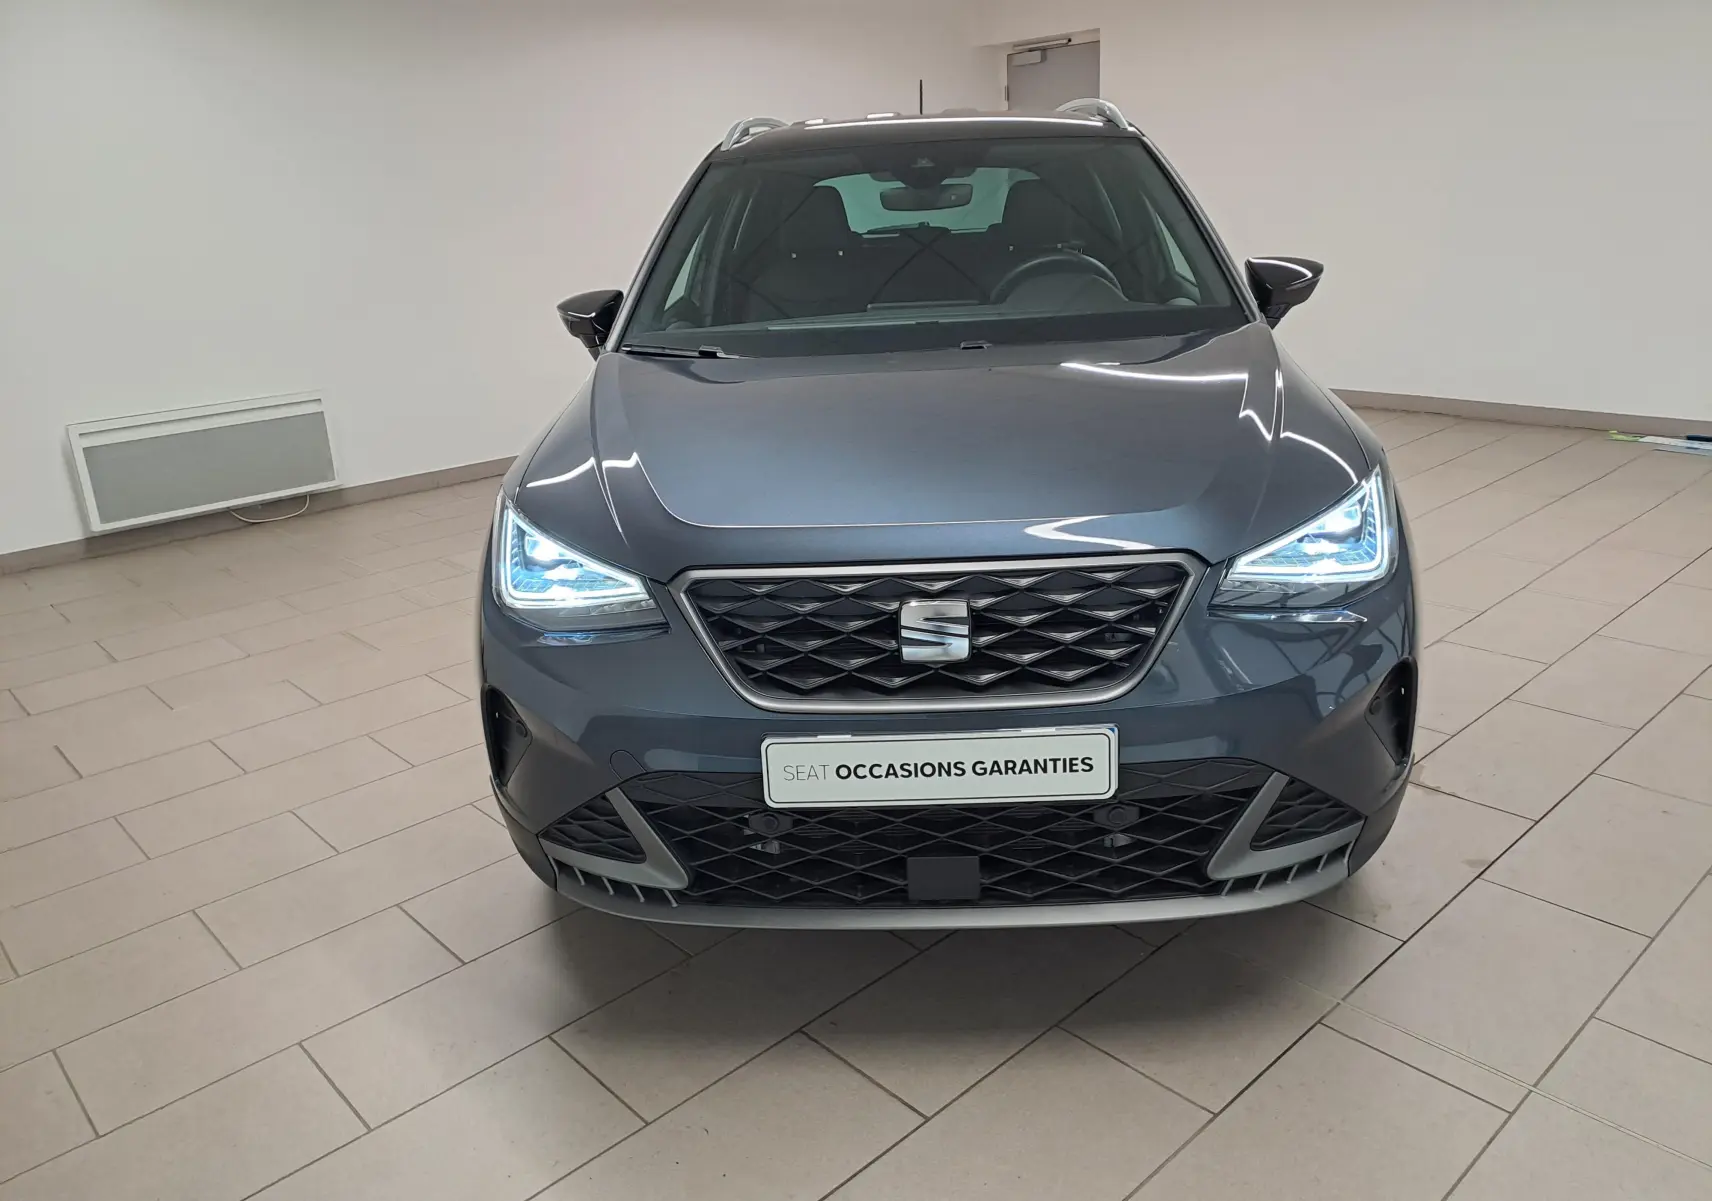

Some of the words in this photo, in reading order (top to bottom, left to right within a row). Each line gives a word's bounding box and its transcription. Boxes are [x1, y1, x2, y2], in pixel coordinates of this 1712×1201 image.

[783, 764, 831, 781] SEAT
[835, 760, 966, 780] OCCASIONS
[971, 756, 1094, 777] GARANTIES
